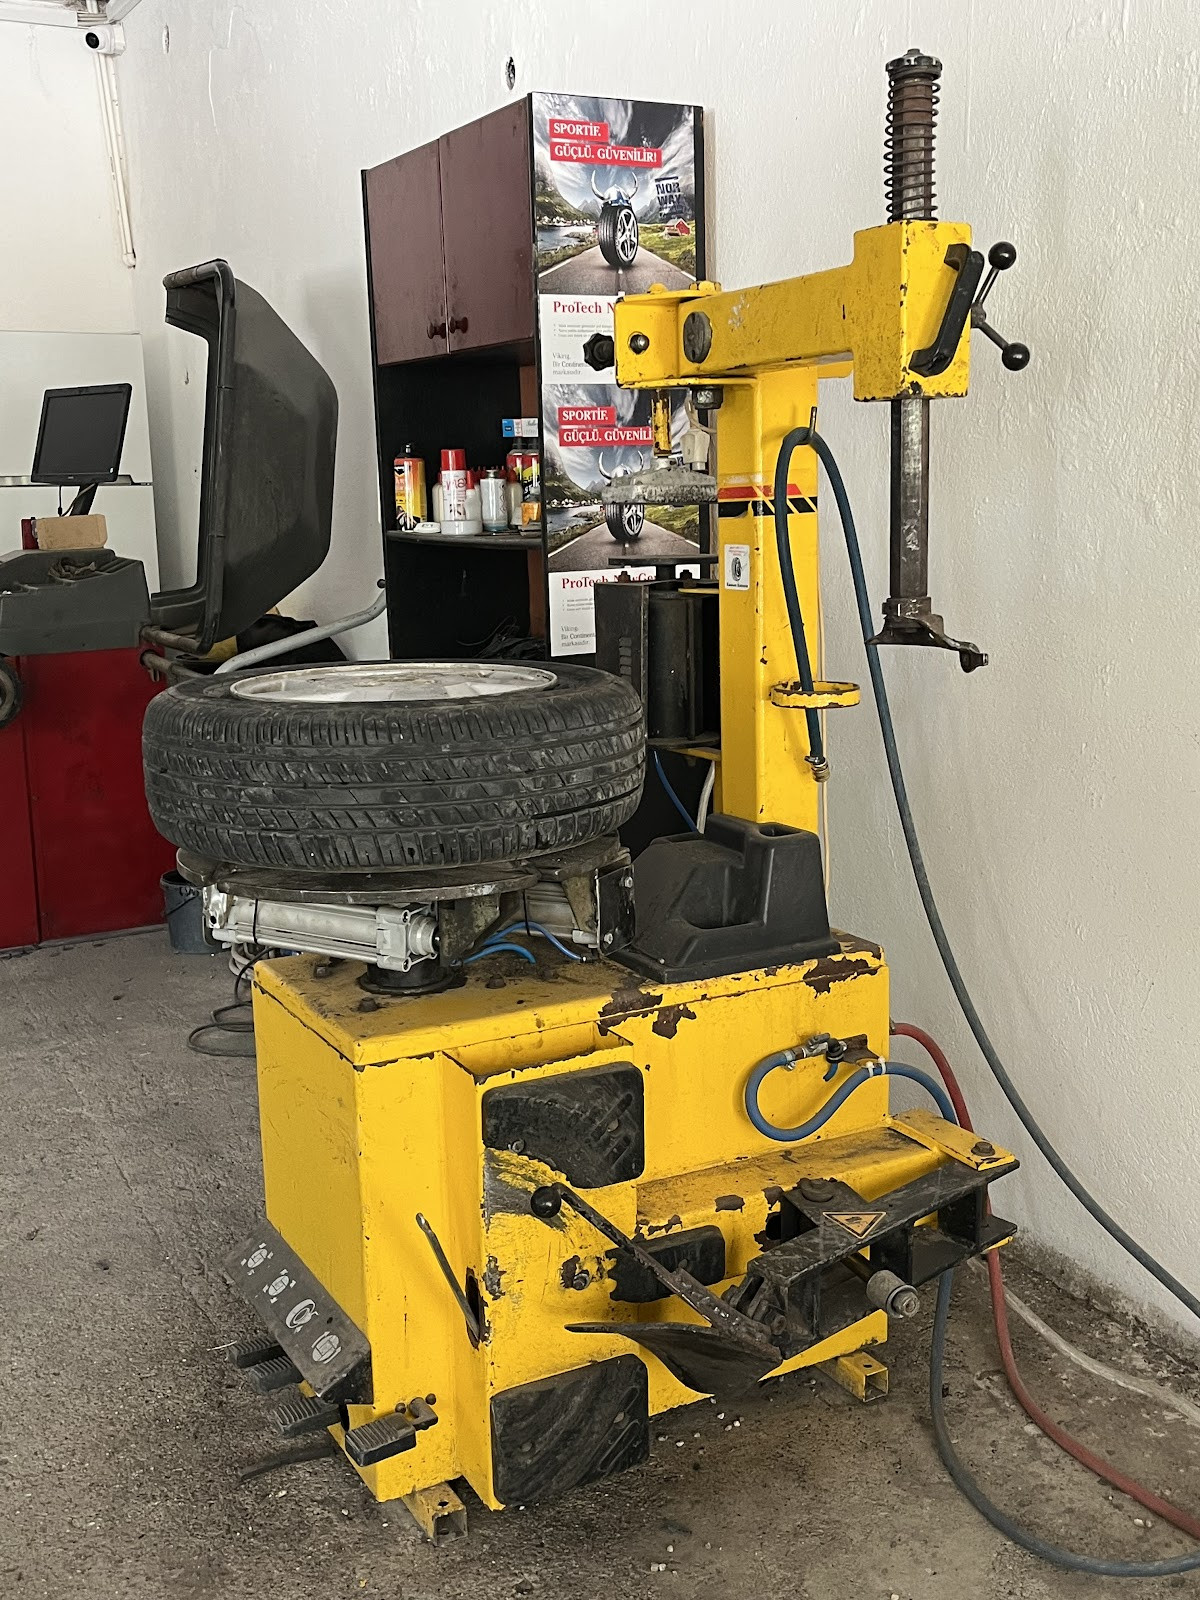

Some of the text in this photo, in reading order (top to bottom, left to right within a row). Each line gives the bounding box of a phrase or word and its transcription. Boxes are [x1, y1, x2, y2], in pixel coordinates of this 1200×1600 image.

[553, 122, 602, 137] SPORTİF.
[554, 144, 657, 163] GÜÇLÜ. GÜVENİLİR!
[655, 181, 681, 195] NOR
[553, 301, 602, 314] ProTech
[562, 407, 609, 421] SPORTİF.
[563, 429, 654, 443] GÜÇLÜ. GÜVENİLİ
